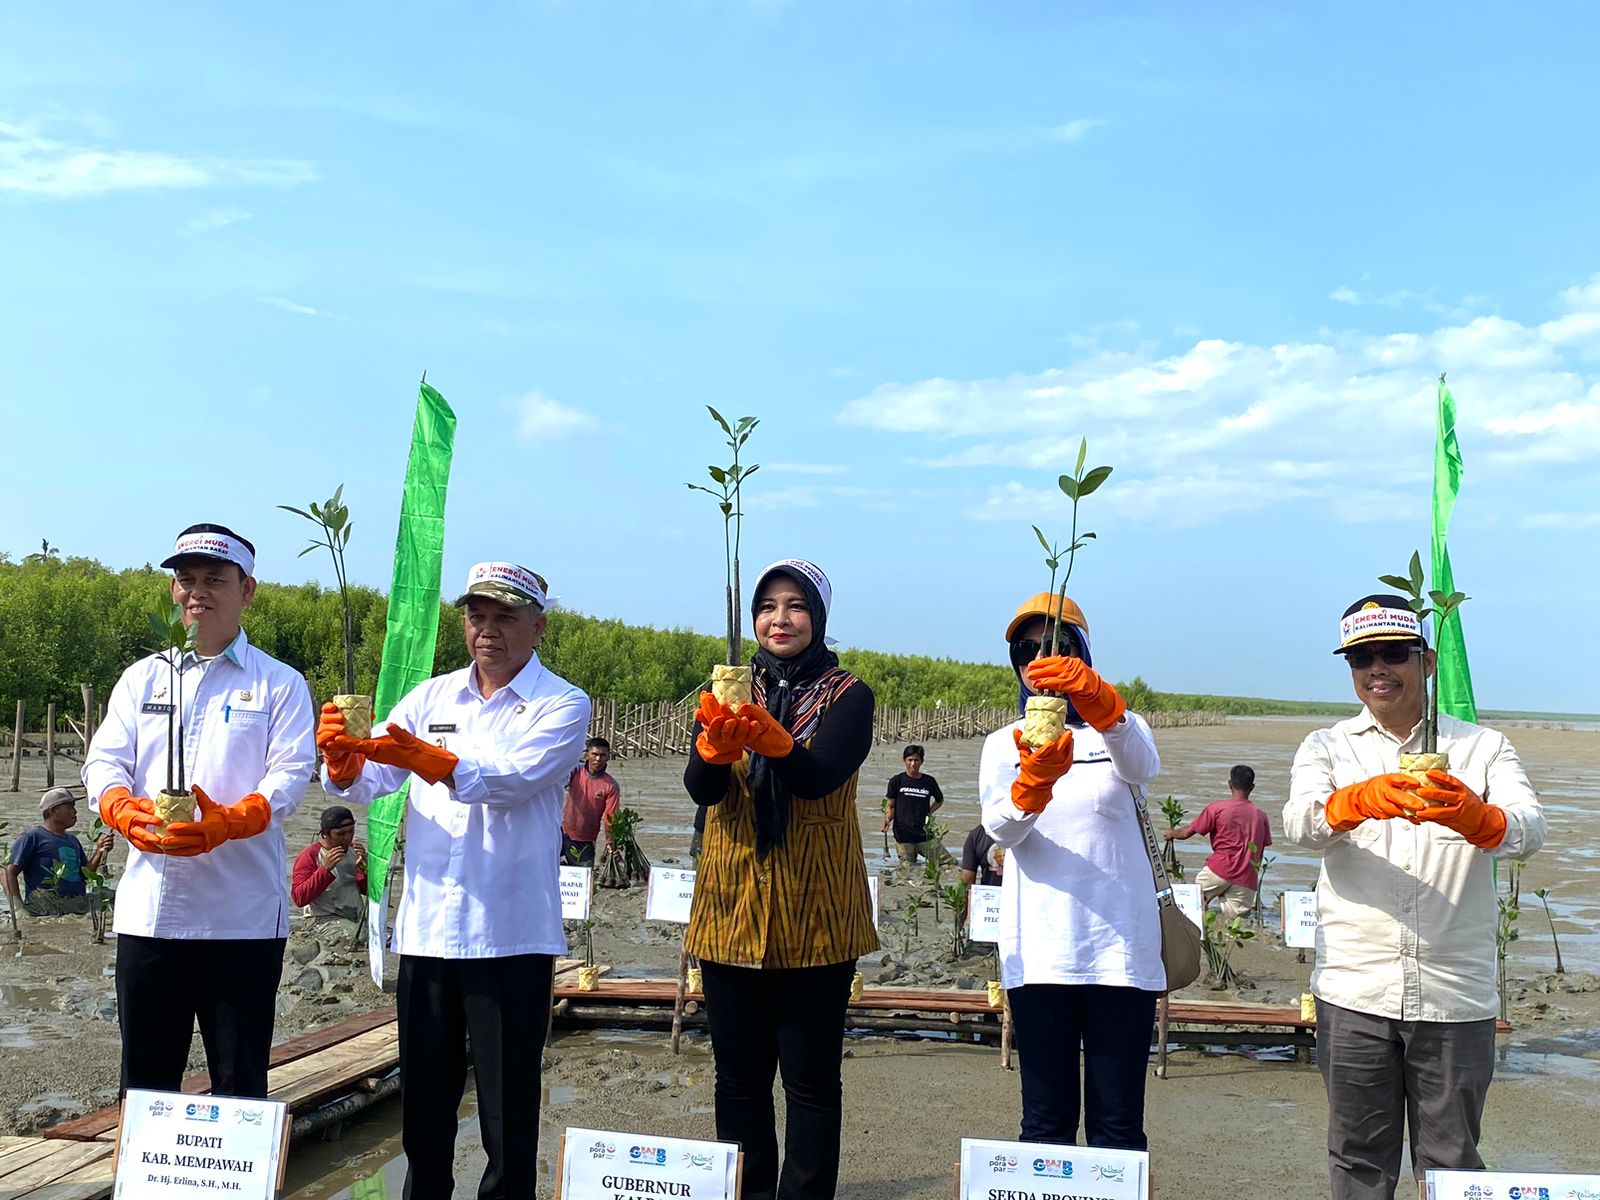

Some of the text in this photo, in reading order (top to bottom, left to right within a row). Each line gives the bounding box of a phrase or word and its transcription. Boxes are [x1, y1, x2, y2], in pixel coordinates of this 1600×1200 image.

[204, 540, 229, 549] MUDA
[1355, 614, 1415, 625] ENERGI MUDA
[1355, 621, 1416, 631] KALIMANTAN BARAT
[1143, 813, 1165, 880] VERBEST
[176, 1133, 223, 1149] BUPATI
[141, 1151, 253, 1173] KAB. MEMPAWAH
[147, 1174, 242, 1191] Dr. Hj. Erlina, S.H., M.H.
[602, 1175, 691, 1197] GUBERNUR
[988, 1188, 1036, 1200] SEKDA
